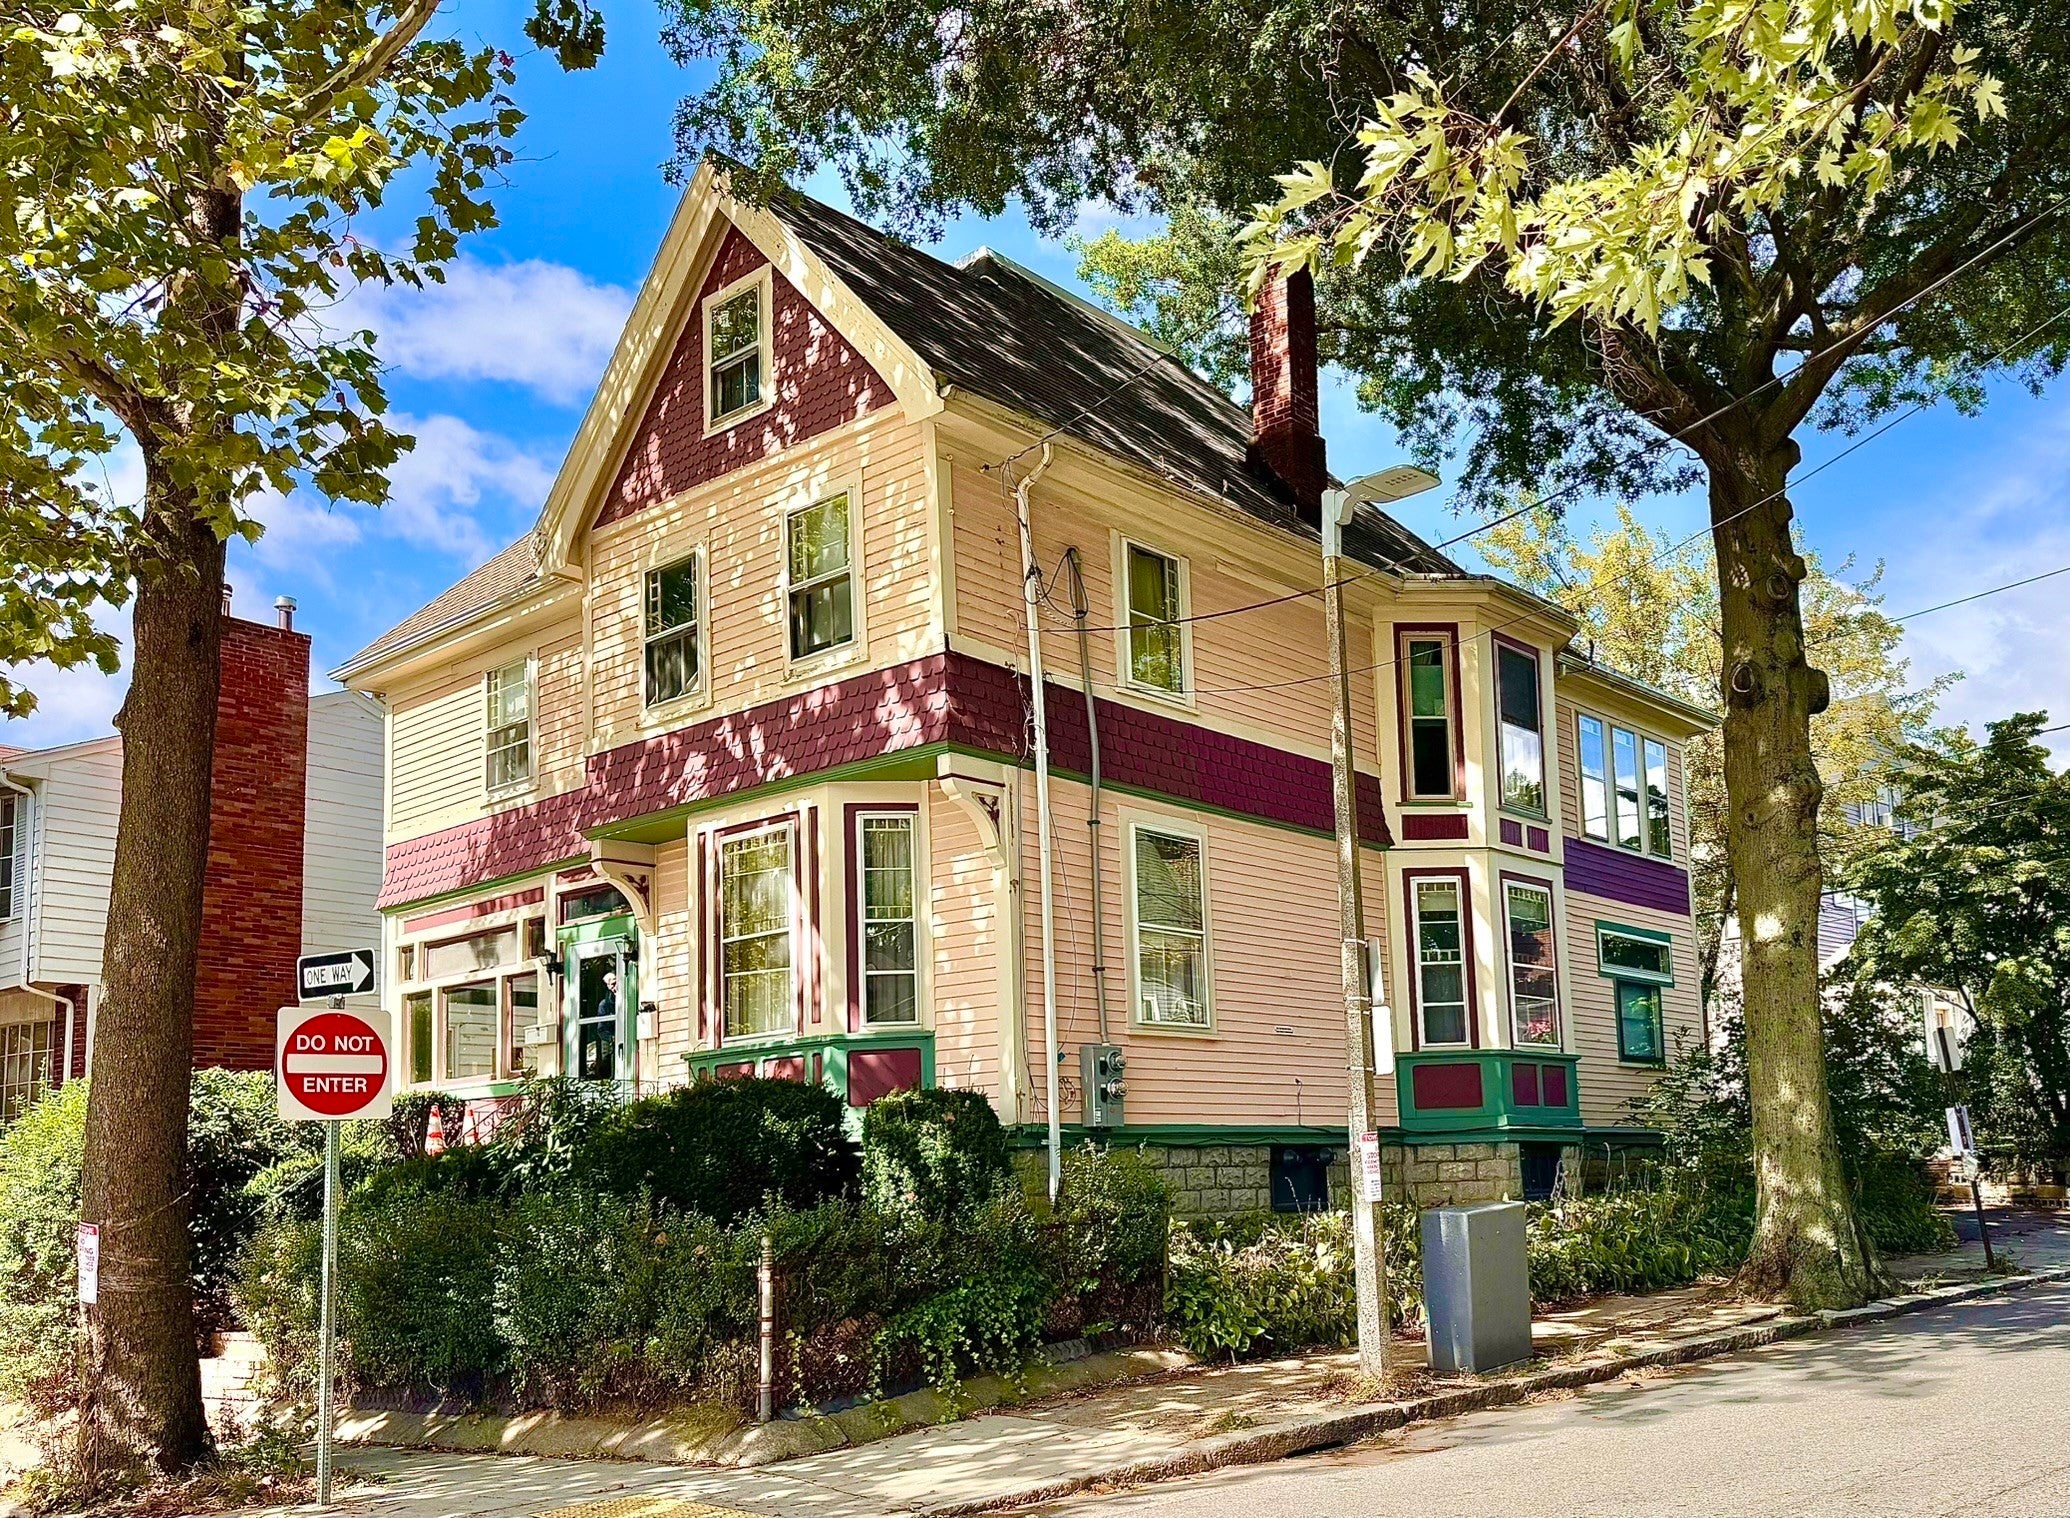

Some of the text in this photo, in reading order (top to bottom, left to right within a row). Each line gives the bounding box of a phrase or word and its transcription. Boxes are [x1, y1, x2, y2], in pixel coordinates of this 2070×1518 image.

[306, 964, 353, 985] ONE WAY
[296, 1034, 374, 1052] DO NOT
[303, 1077, 367, 1093] ENTER
